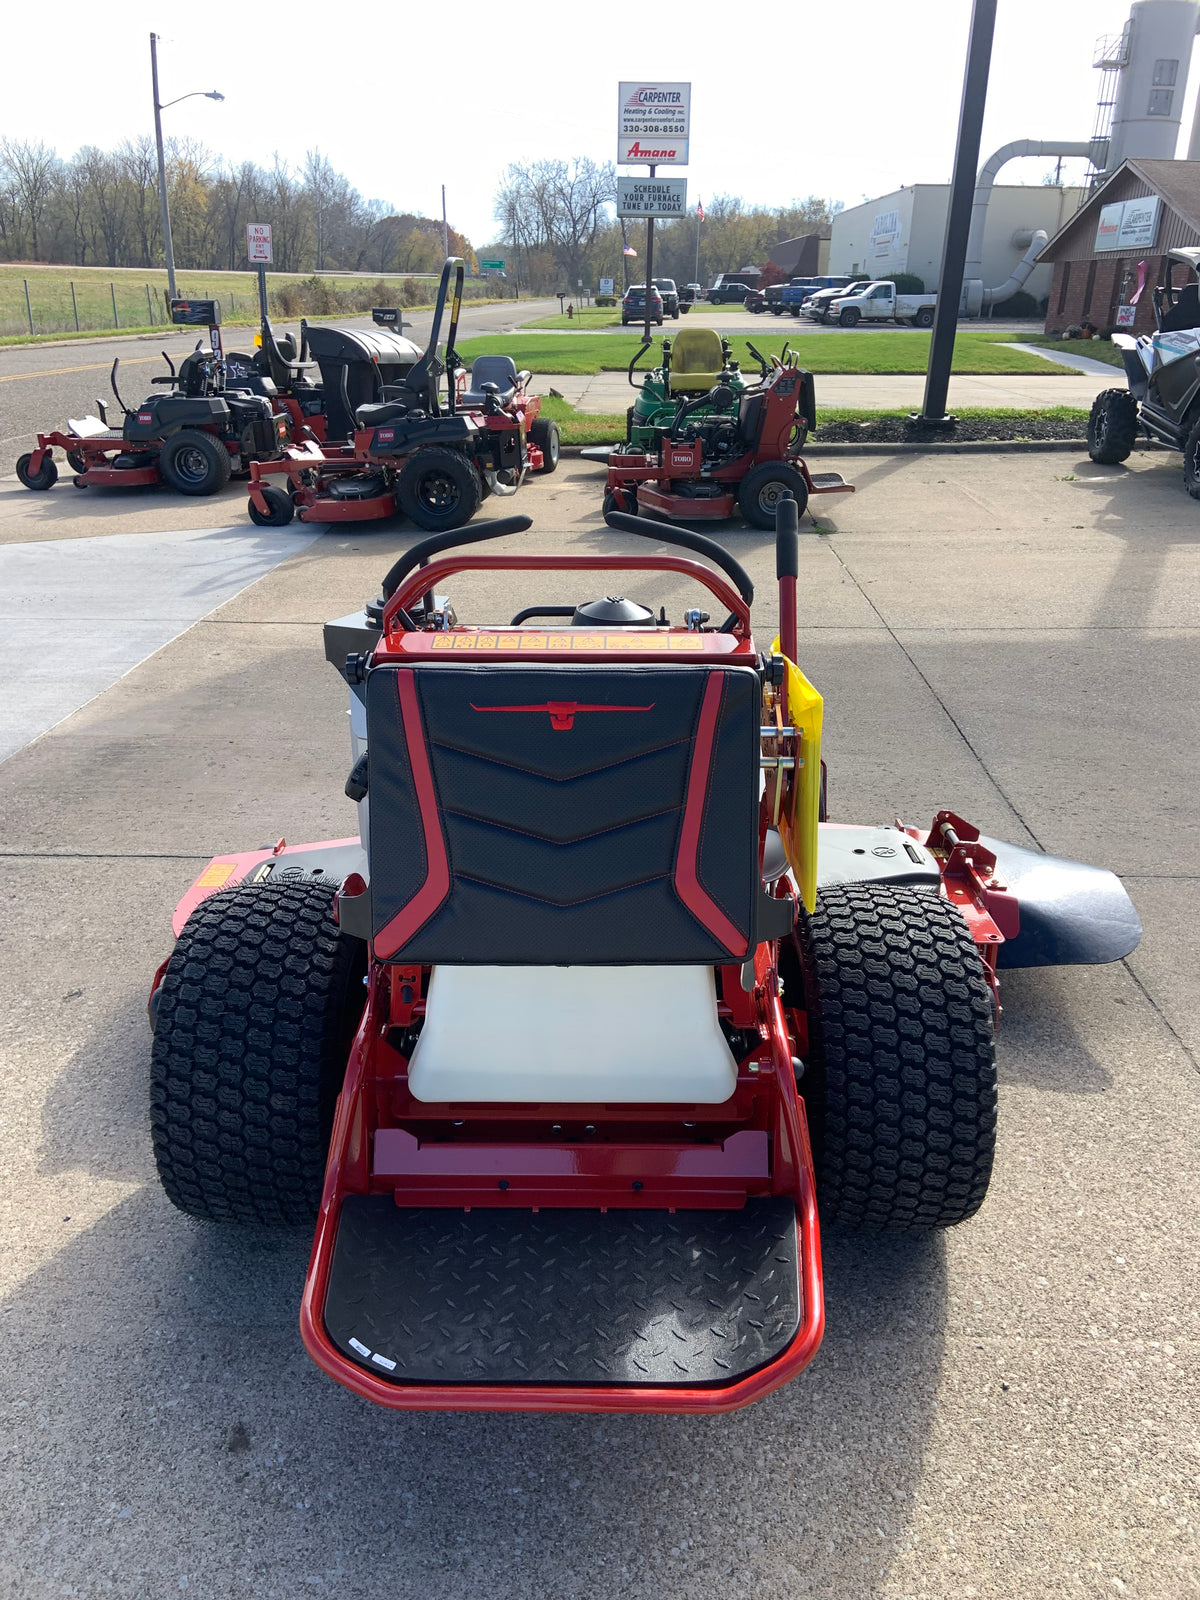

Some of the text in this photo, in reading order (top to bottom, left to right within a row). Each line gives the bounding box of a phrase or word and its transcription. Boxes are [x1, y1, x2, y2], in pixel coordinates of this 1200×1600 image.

[638, 91, 681, 103] CARPENTER
[623, 108, 647, 116] Heating
[654, 108, 676, 116] Cooling
[627, 141, 677, 157] Amana
[633, 185, 671, 193] SCHEDULE
[624, 193, 681, 202] YOUR FURNACE
[623, 202, 682, 211] TUNE UP TODAY
[254, 227, 264, 235] NO
[248, 234, 270, 243] PARKING
